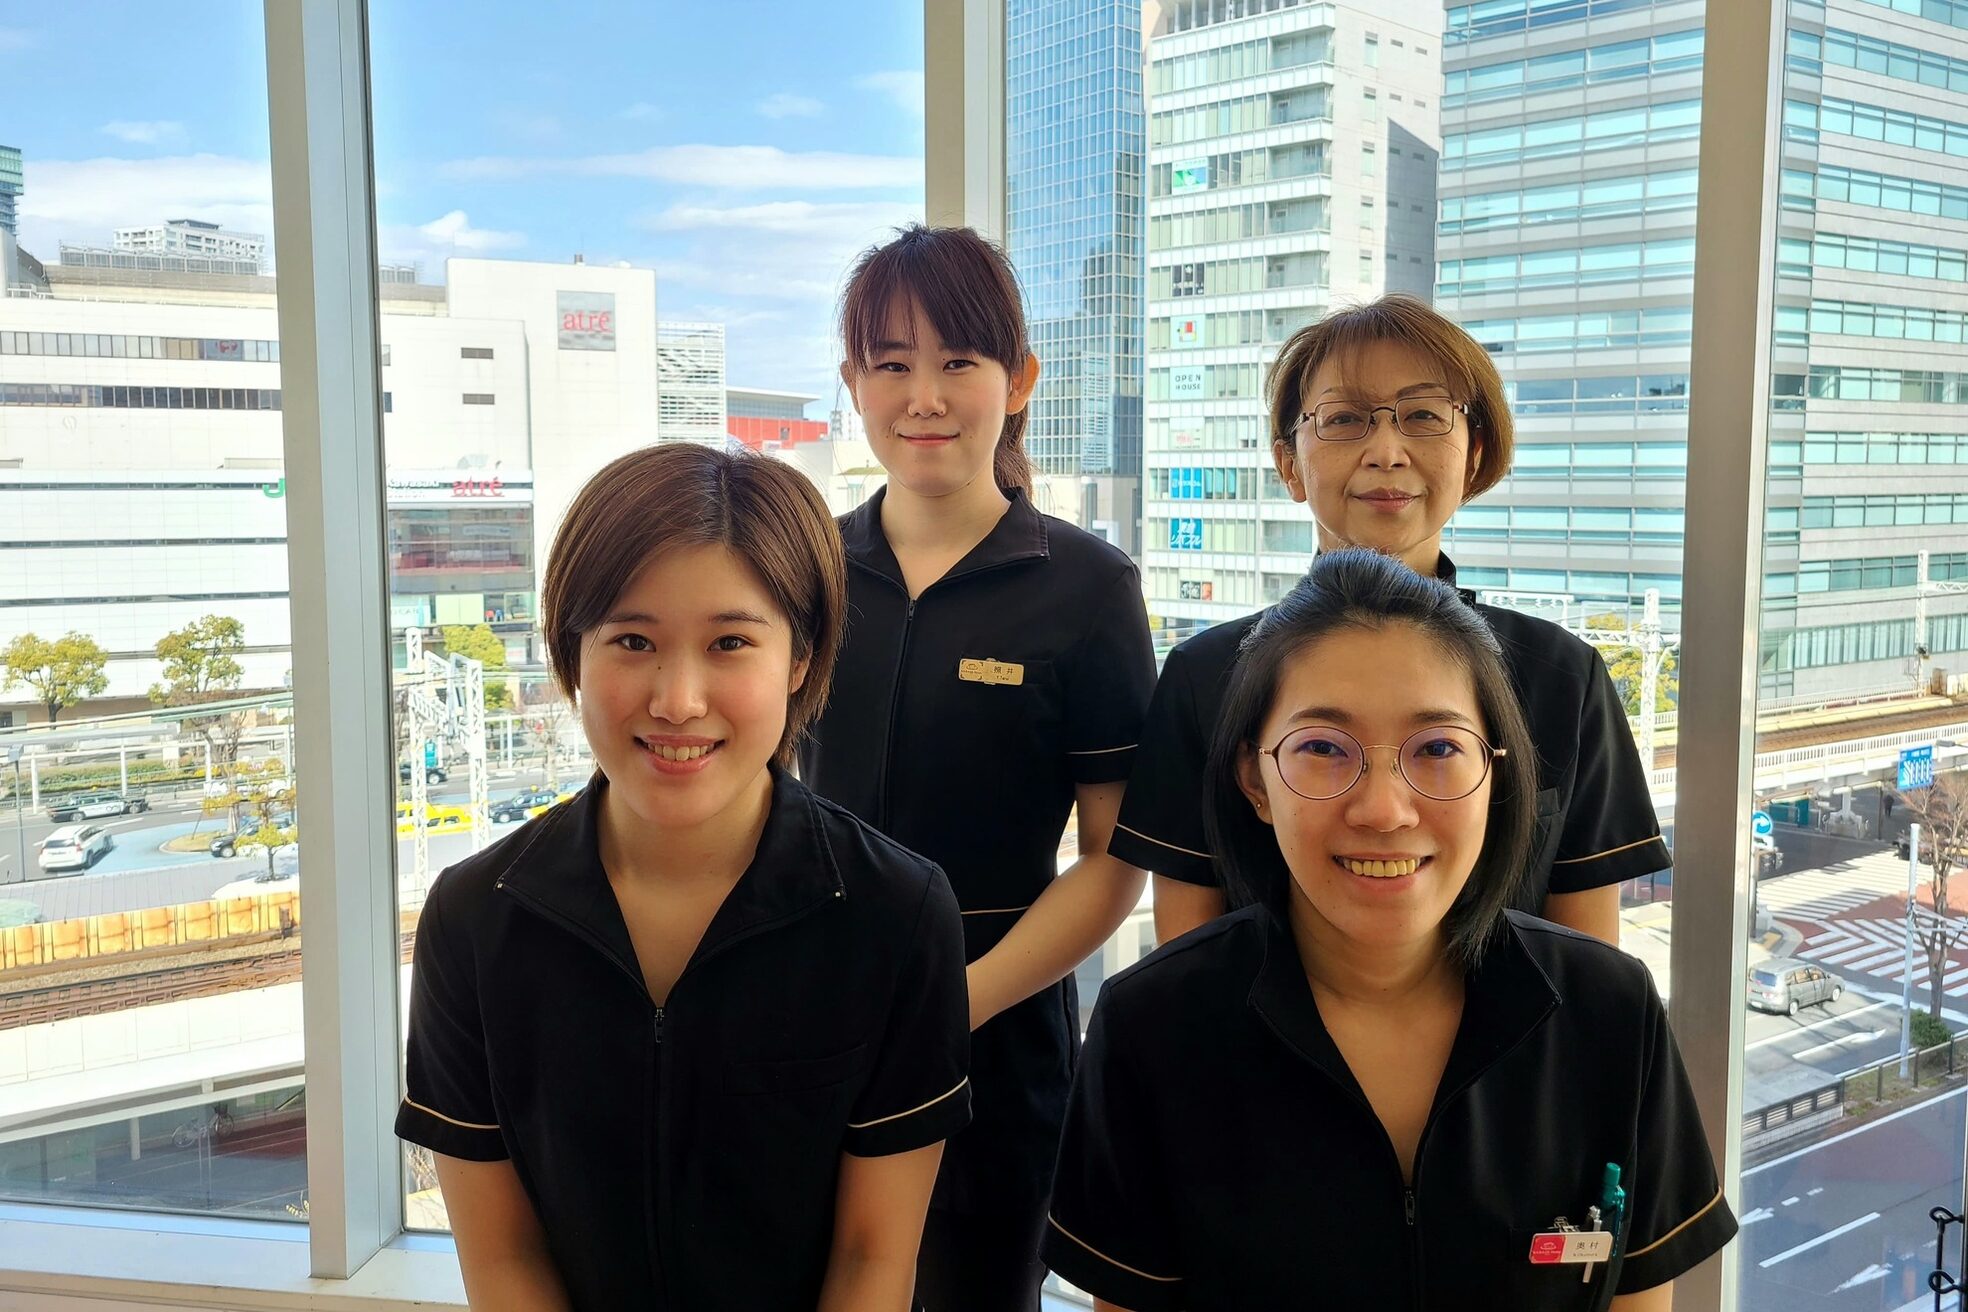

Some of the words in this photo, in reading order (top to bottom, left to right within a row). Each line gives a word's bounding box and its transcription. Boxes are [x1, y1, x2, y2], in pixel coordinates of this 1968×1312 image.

[563, 309, 611, 332] atré
[1175, 374, 1201, 382] OPEN
[1175, 383, 1201, 391] HOUSE
[451, 476, 504, 497] atré
